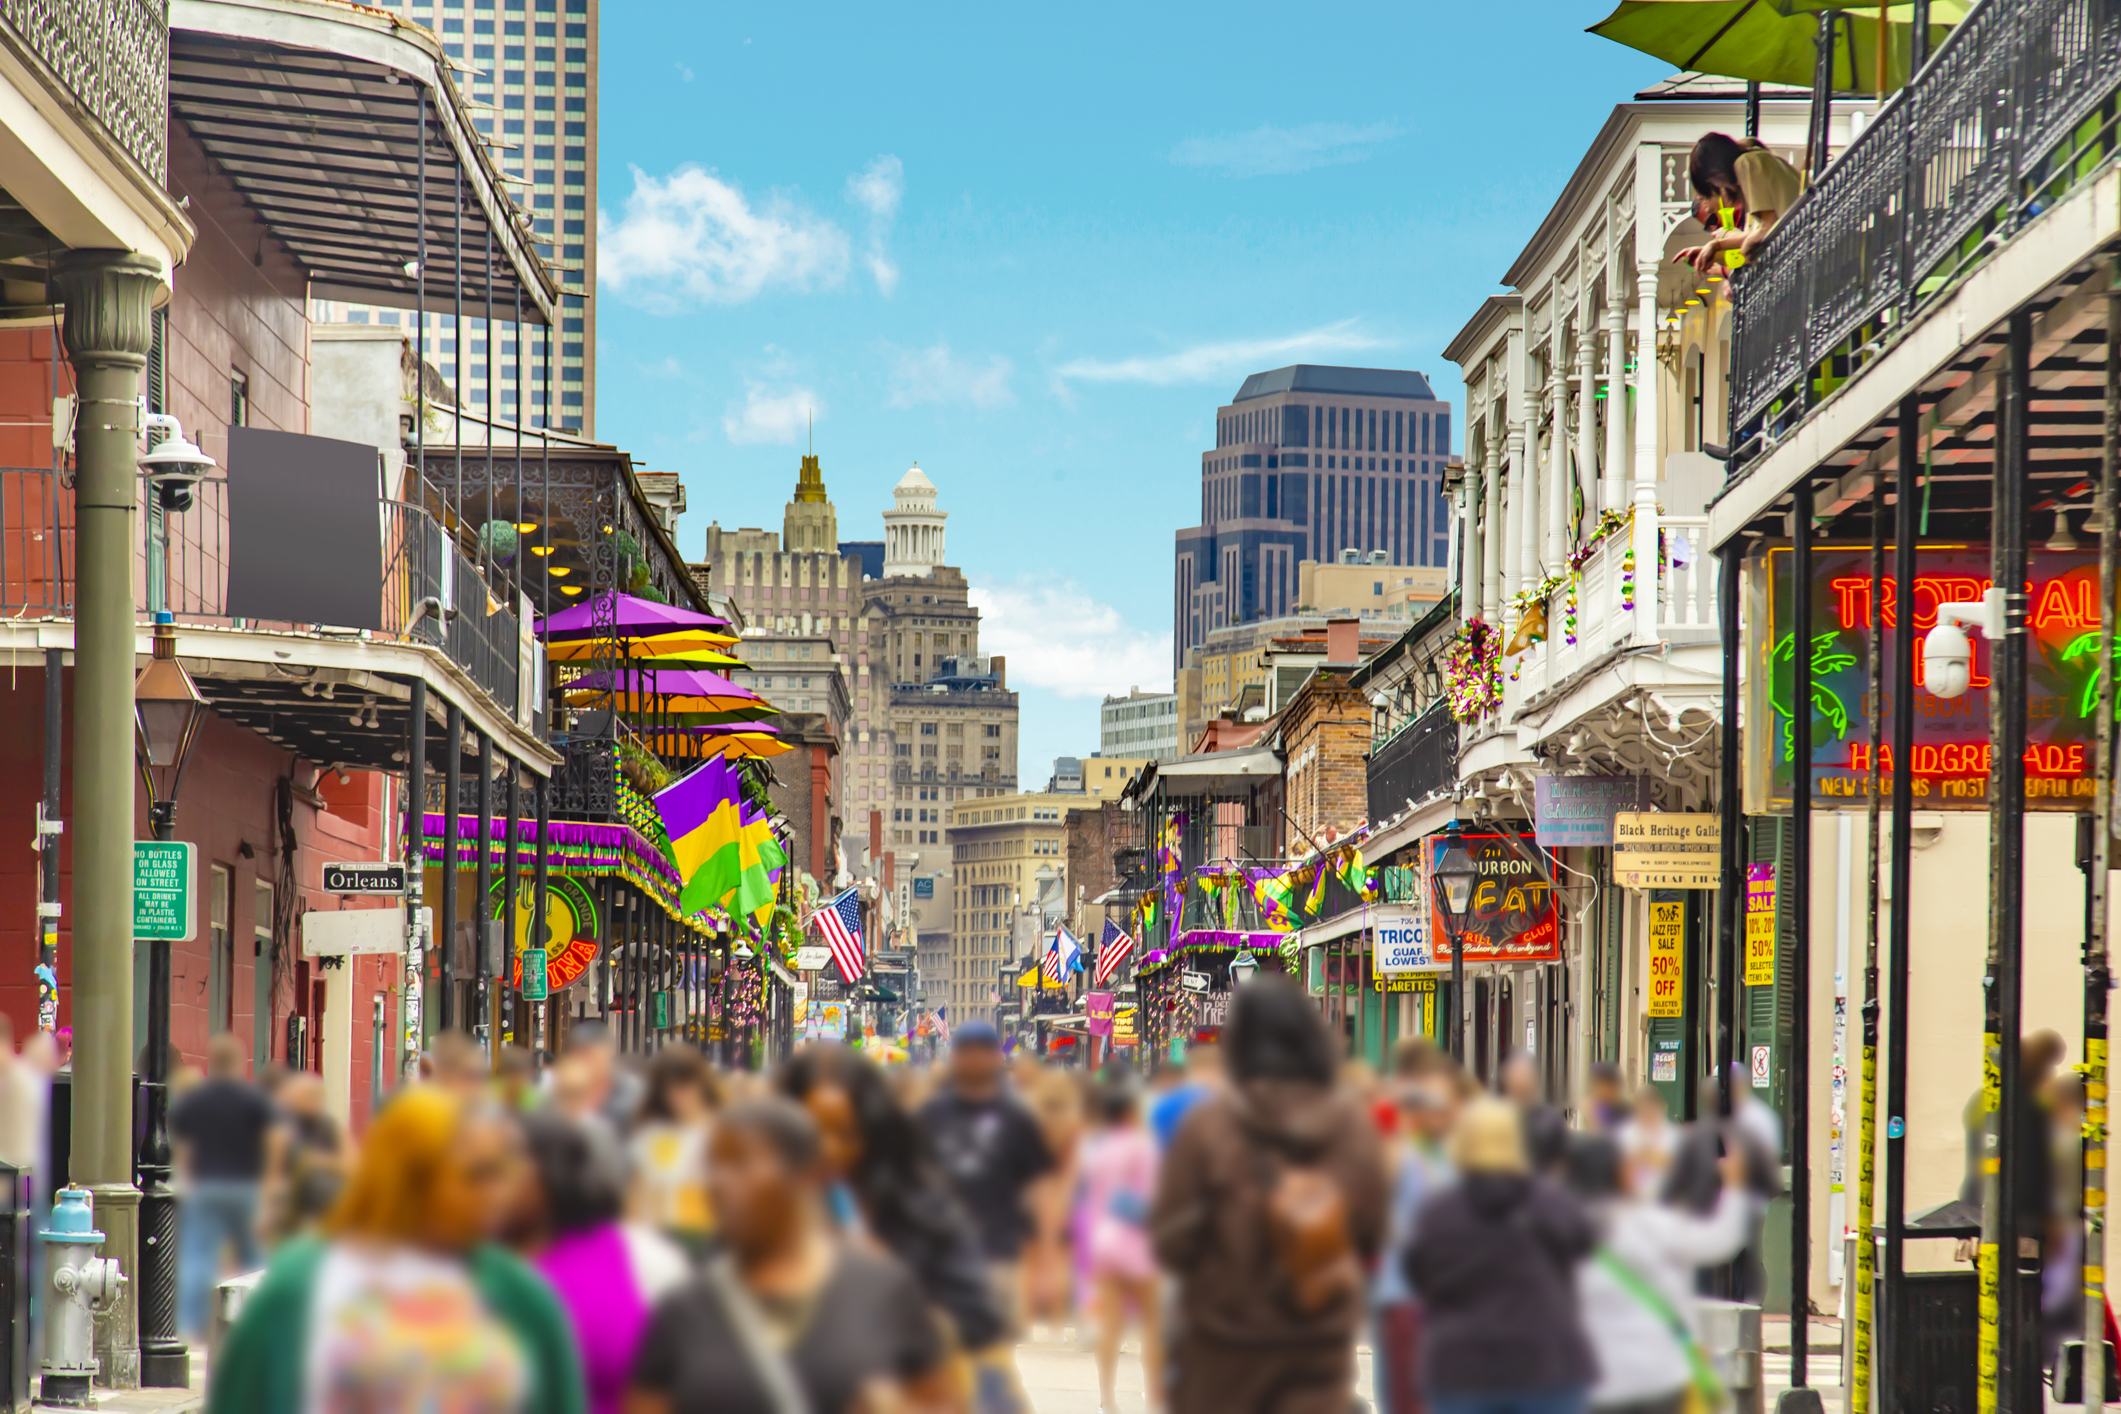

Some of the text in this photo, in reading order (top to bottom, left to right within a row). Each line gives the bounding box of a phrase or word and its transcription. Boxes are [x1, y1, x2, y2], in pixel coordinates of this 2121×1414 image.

[1832, 576, 2103, 629] TROPAL
[1850, 743, 2083, 773] HADGREADE
[1820, 777, 1858, 797] NEW
[1539, 823, 1605, 833] CUSTOM FRAMING
[1619, 824, 1720, 841] Black Heritage Galle
[148, 850, 182, 860] BOTTLES
[1484, 848, 1501, 858] 711
[138, 859, 178, 869] OR GLASS
[1479, 859, 1532, 876] URBON
[140, 869, 177, 878] ALLOWED
[1645, 875, 1685, 883] KODAK
[136, 878, 180, 887] ON STREET
[330, 872, 398, 888] Orleans
[916, 880, 932, 888] AC
[1764, 880, 1775, 892] GRA
[138, 892, 177, 901] ALL DRINKS
[160, 901, 169, 909] BE
[563, 882, 593, 928] GRANDE
[1748, 895, 1776, 912] SALE
[148, 908, 175, 917] PLASTIC
[136, 916, 177, 925] CONTAINERS
[1748, 918, 1760, 934] 10%
[1523, 922, 1553, 942] CLUB
[1652, 924, 1681, 936] JAZZ FEST
[1379, 928, 1423, 945] TRICO
[1436, 942, 1552, 958] Ba Balcony Courtyard
[1658, 938, 1675, 950] SALE
[1752, 940, 1773, 957] 50%
[1652, 956, 1680, 976] 50%
[1748, 973, 1762, 982] ITEMS
[1374, 980, 1436, 993] CGARETTES
[1655, 979, 1675, 996] OFF
[1207, 991, 1233, 1001] MAIS
[1653, 1000, 1678, 1008] SELECTED
[1091, 1009, 1113, 1019] LSU
[1666, 1008, 1680, 1016] ONLY
[1833, 1068, 1844, 1077] 40
